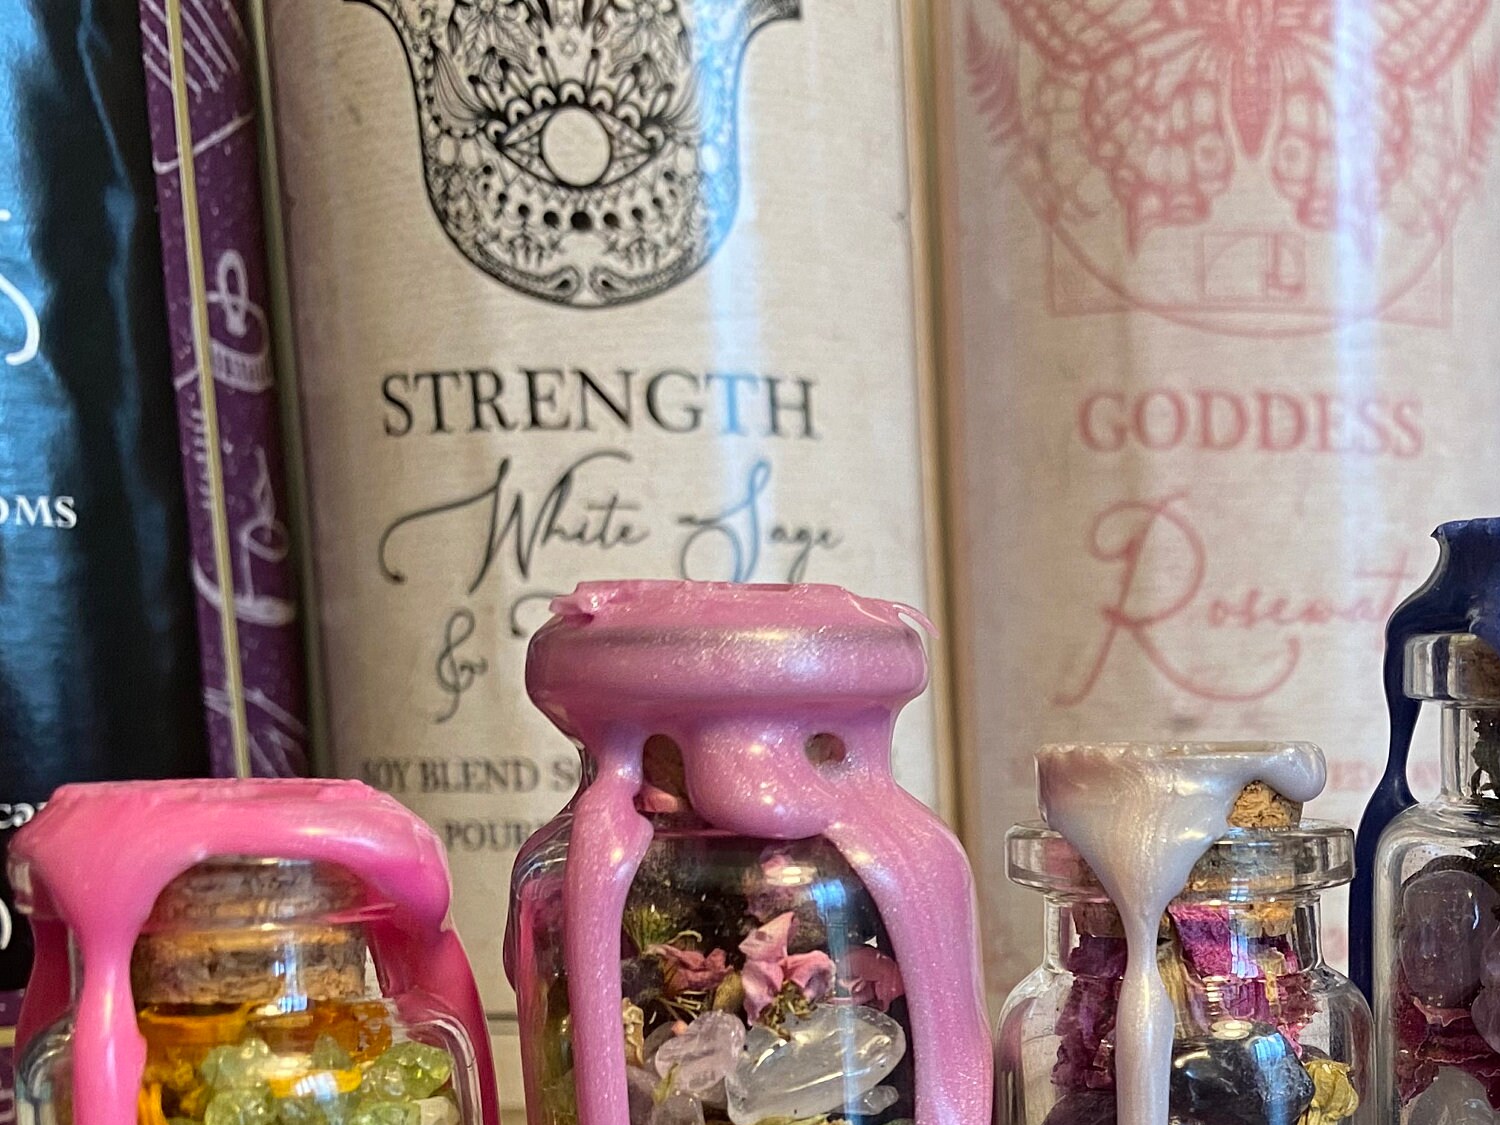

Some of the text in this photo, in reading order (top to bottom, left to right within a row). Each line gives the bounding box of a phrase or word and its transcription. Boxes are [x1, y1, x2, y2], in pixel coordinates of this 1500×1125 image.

[380, 365, 821, 441] STRENGTH
[1076, 388, 1426, 460] GODDESS
[376, 450, 845, 596] White Sage
[434, 607, 489, 723] &
[417, 756, 541, 794] BLEND
